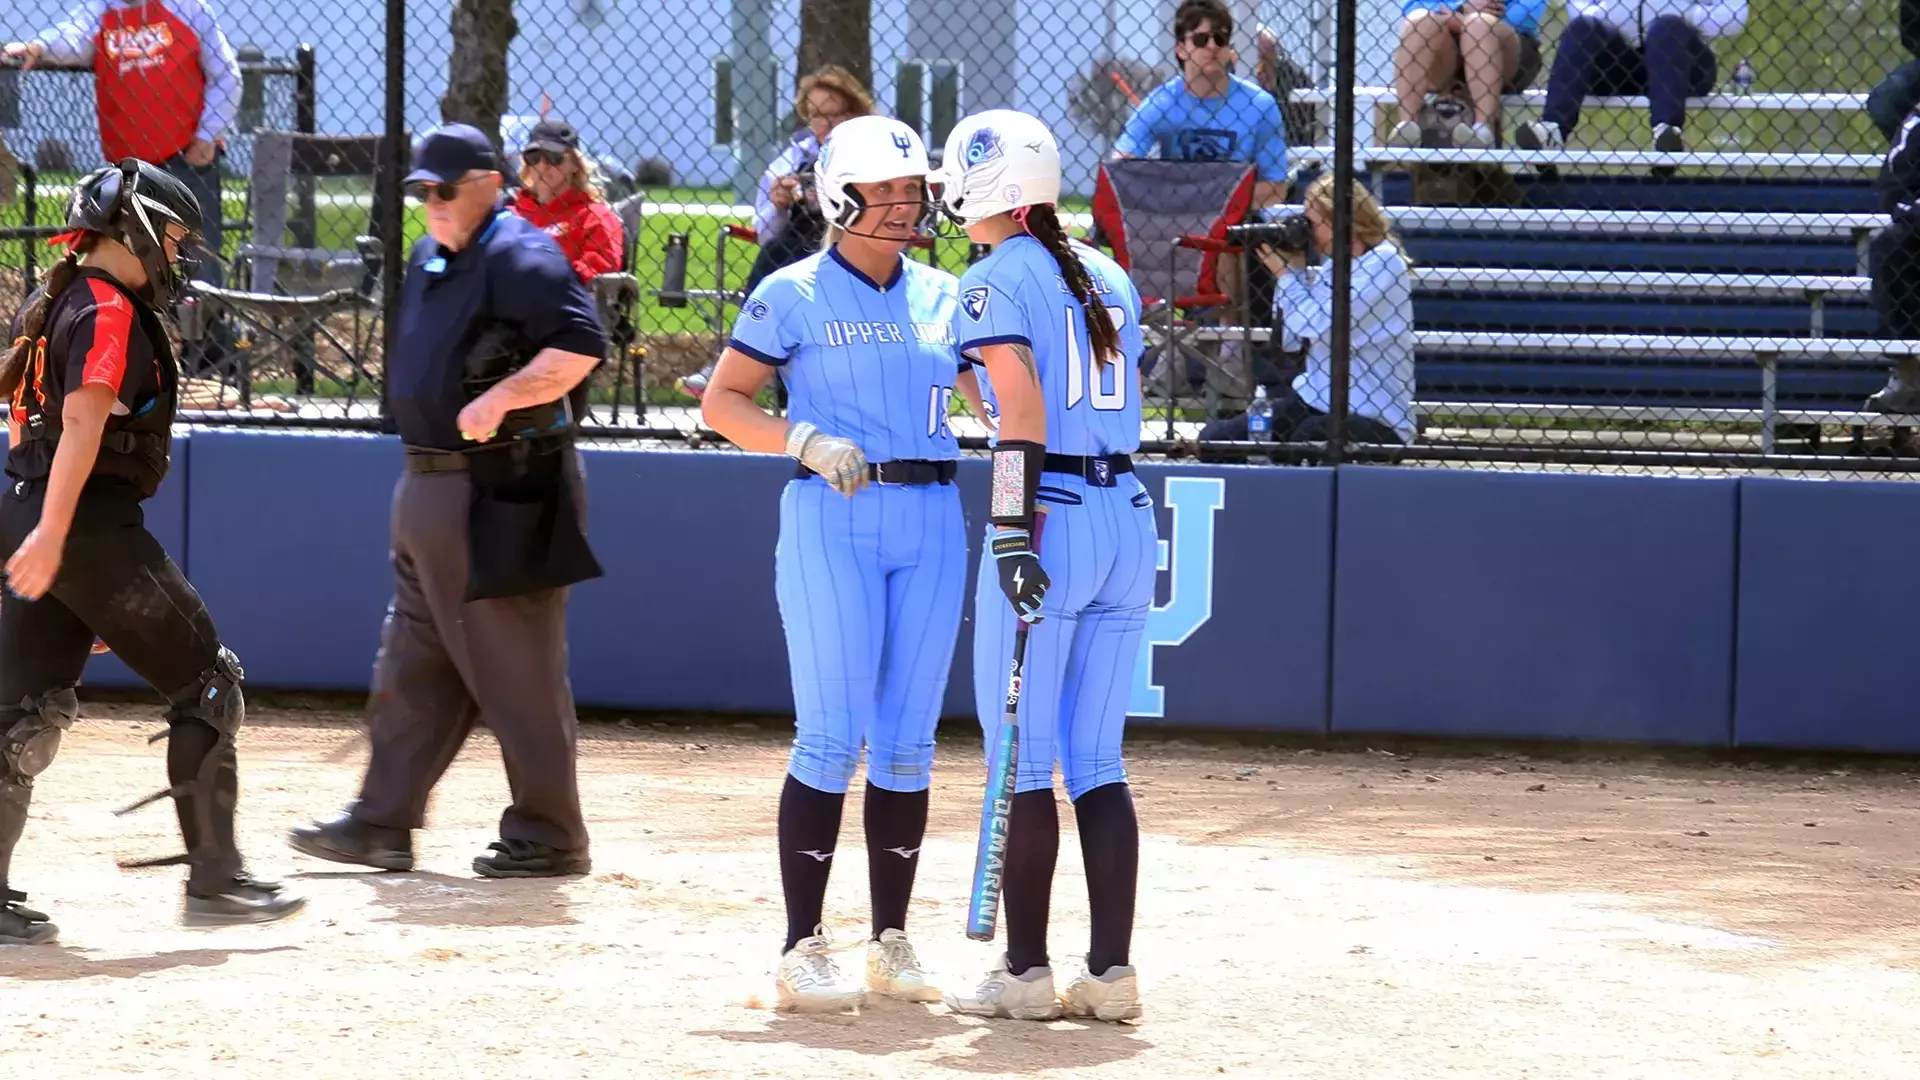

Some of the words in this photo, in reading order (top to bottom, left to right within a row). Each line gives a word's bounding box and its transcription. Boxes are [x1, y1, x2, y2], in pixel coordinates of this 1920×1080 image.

[823, 320, 906, 347] UPPER
[1065, 304, 1127, 411] 16
[976, 798, 1013, 928] DEMARINI
